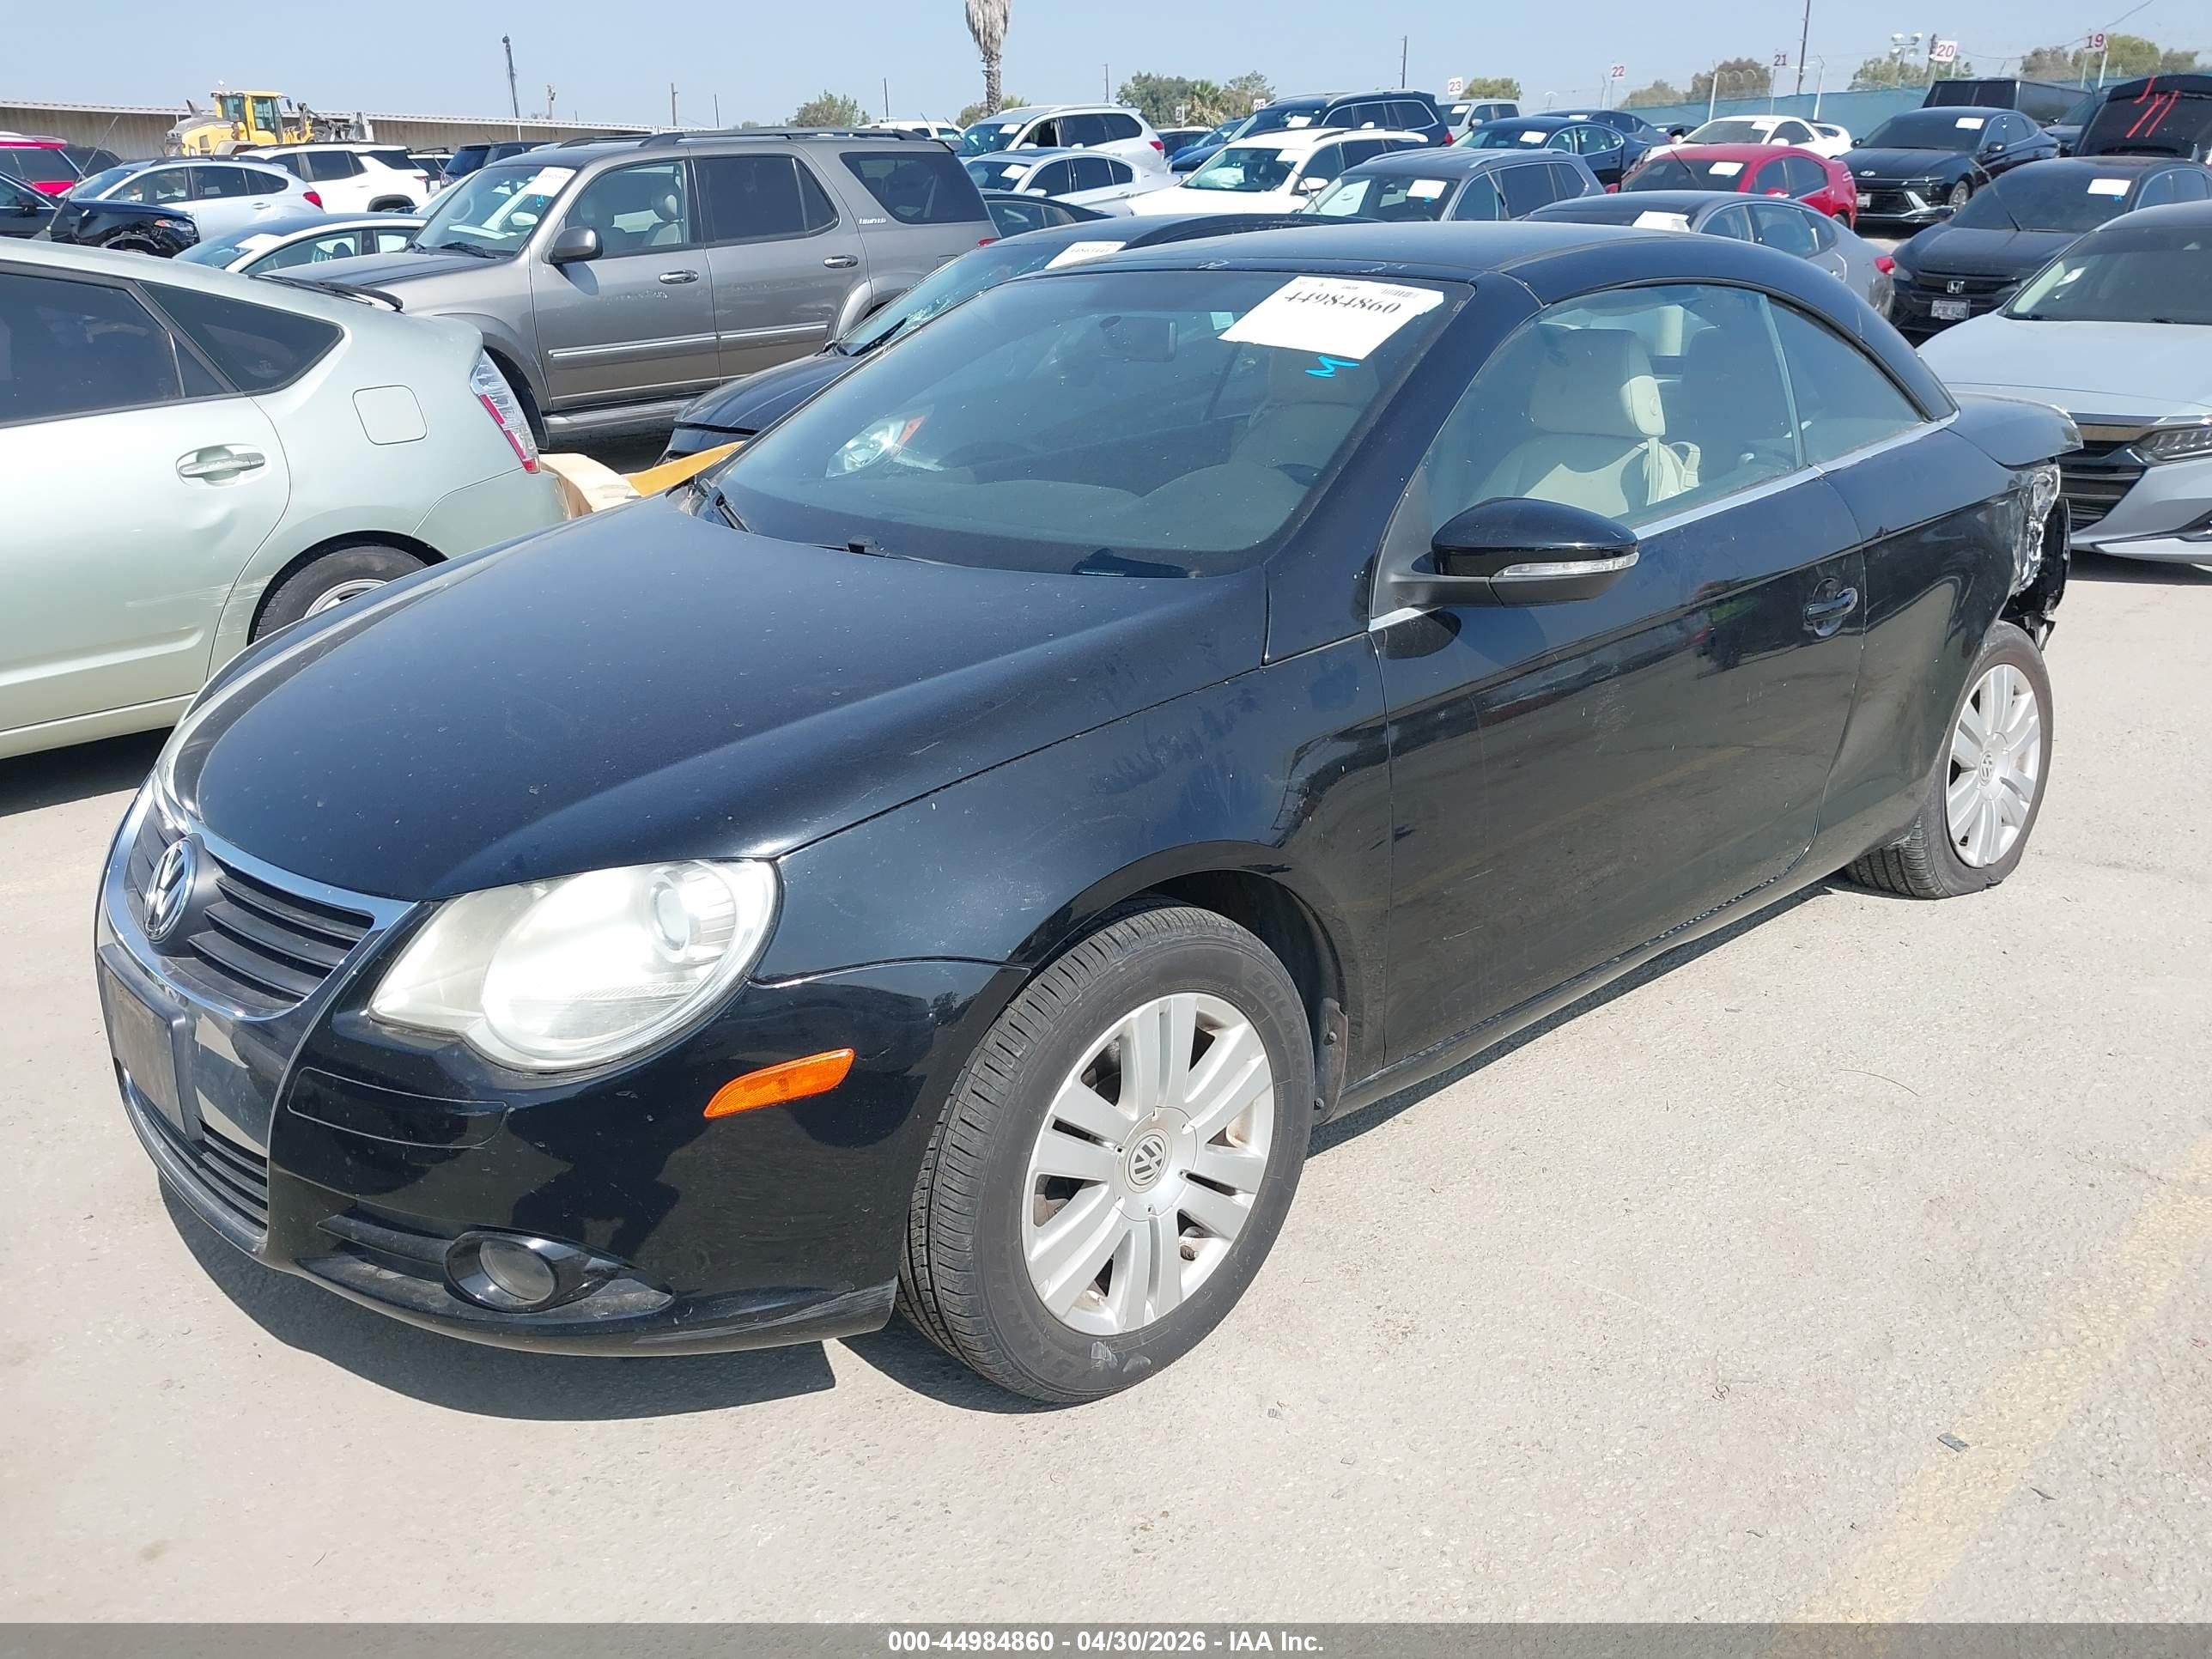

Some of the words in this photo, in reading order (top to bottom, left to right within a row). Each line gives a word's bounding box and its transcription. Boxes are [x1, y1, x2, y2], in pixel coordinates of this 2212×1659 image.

[2085, 33, 2104, 49] 19
[1936, 45, 1954, 58] 20
[1773, 54, 1787, 66] 21
[1612, 65, 1626, 77] 22
[1449, 80, 1462, 92] 23
[1285, 291, 1401, 314] 44984860
